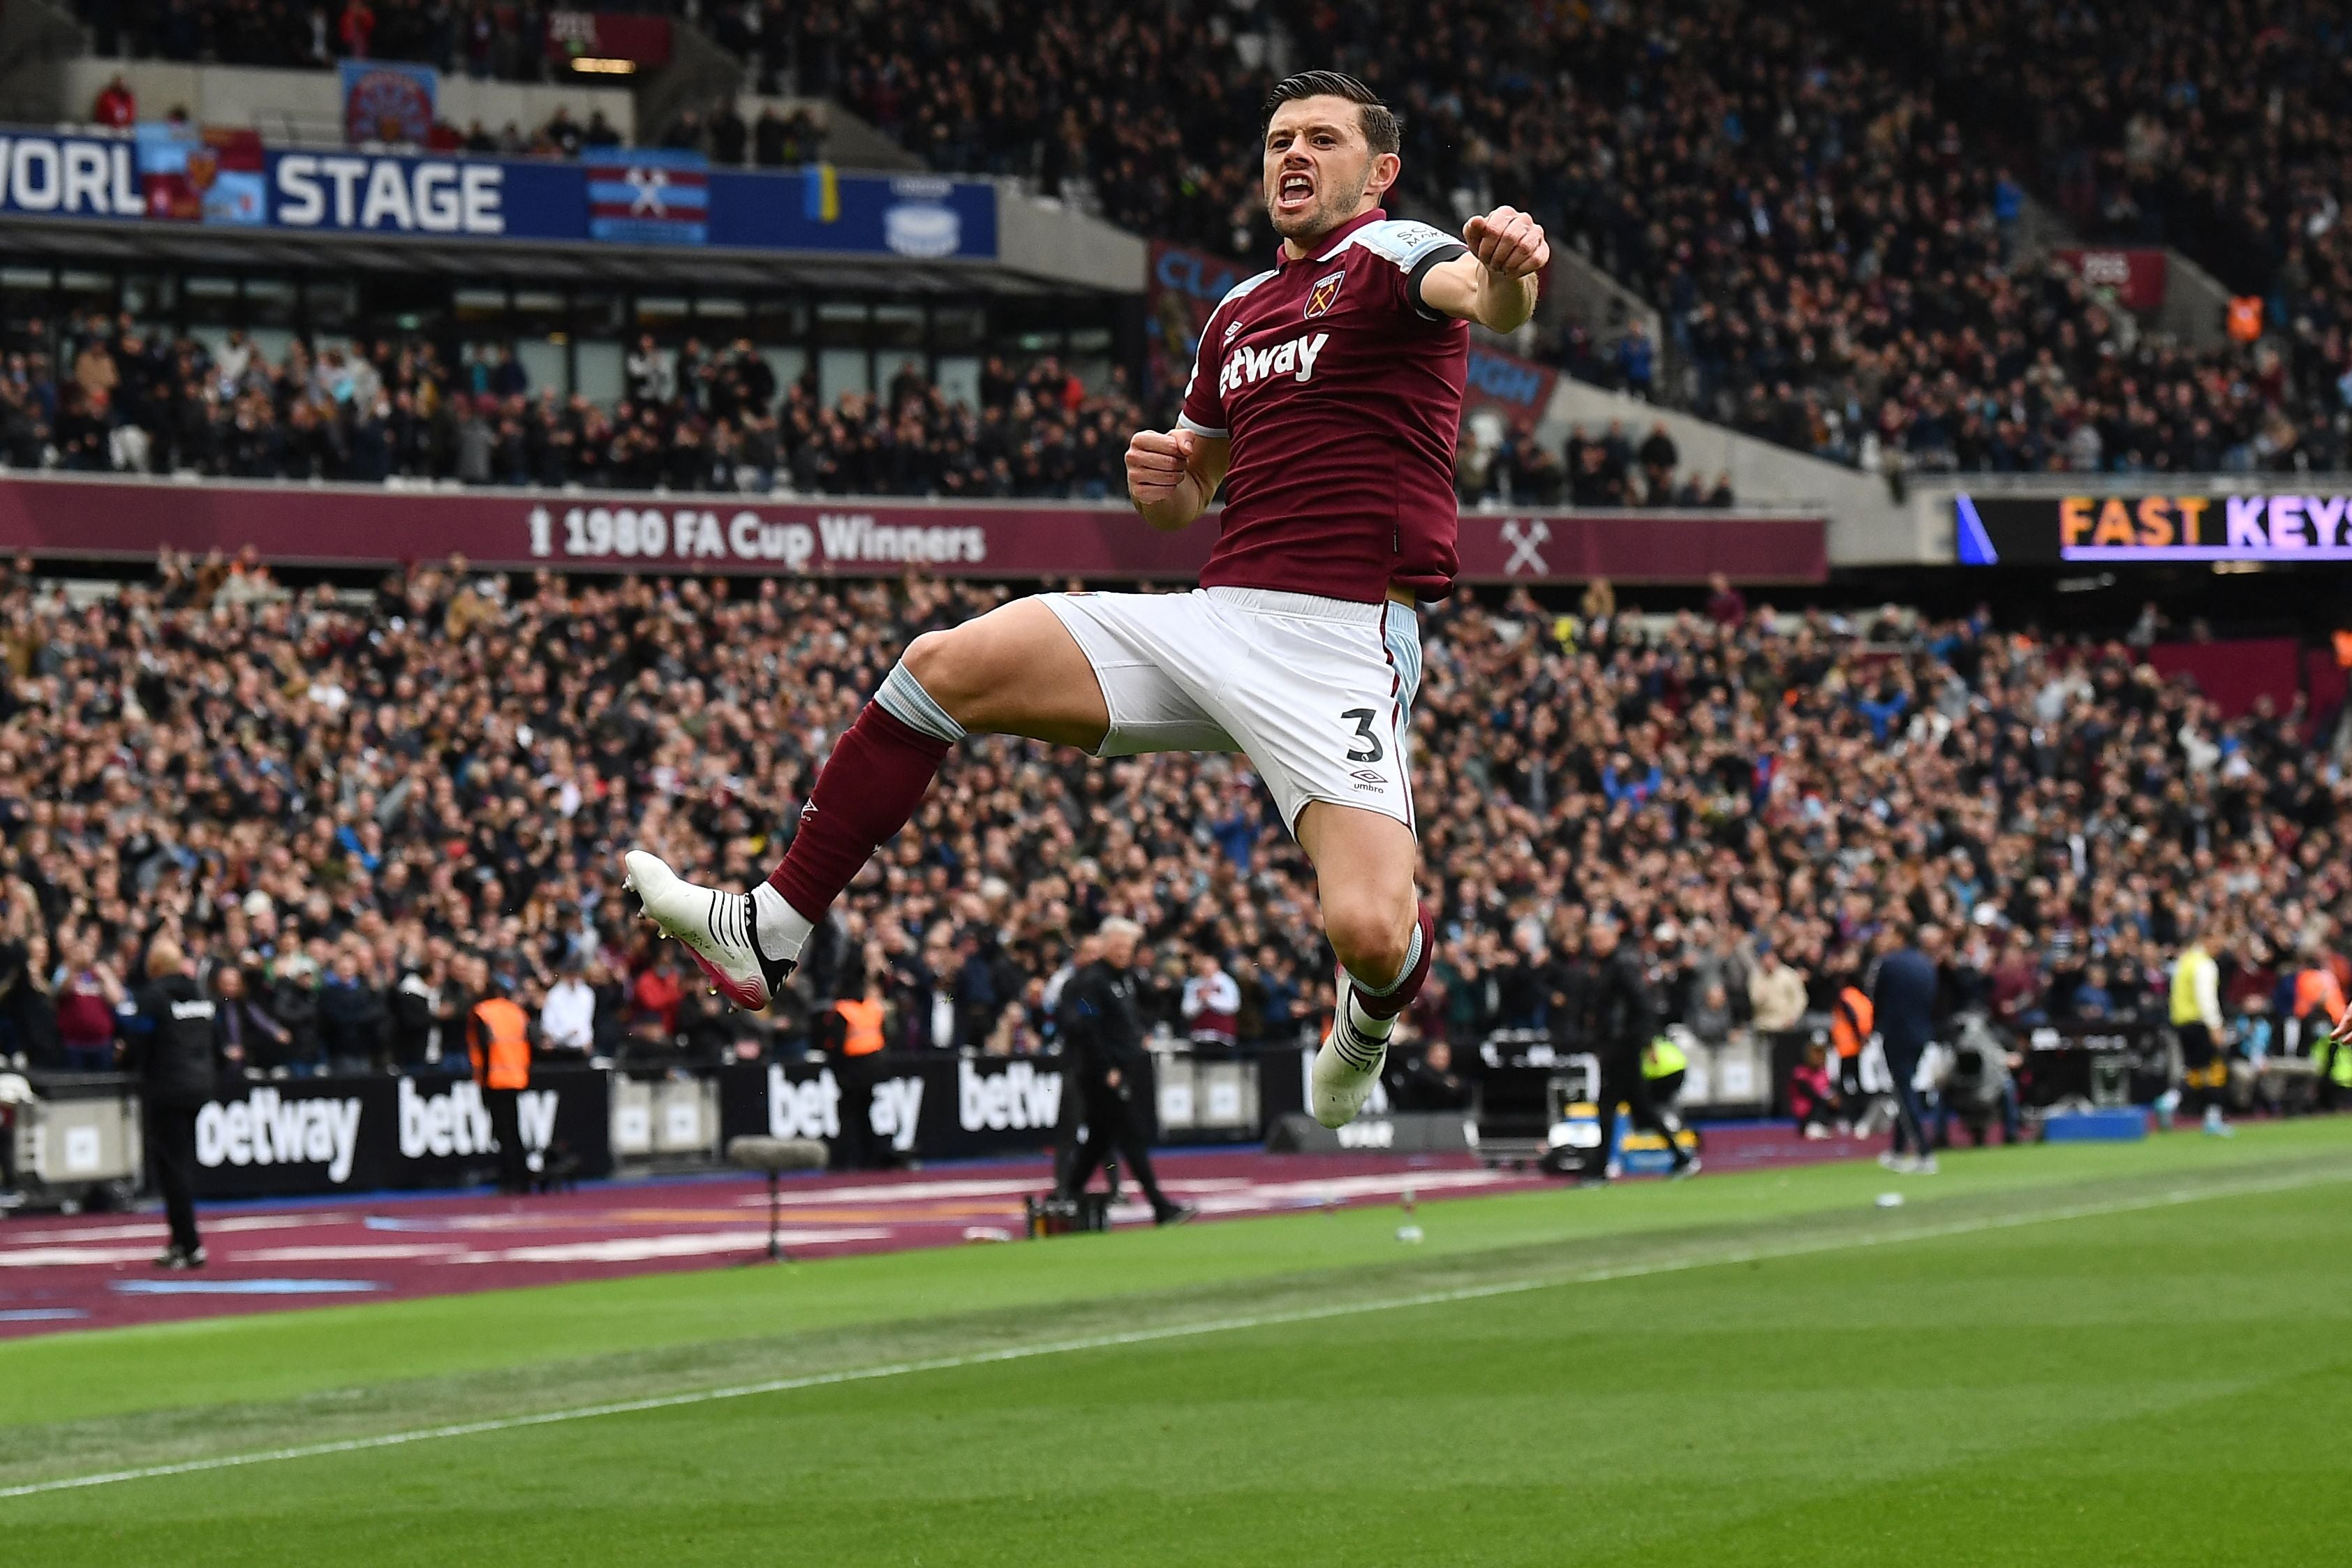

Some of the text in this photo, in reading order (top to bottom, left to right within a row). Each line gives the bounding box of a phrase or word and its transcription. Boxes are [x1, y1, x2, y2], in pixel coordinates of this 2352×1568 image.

[0, 138, 505, 233] ORL STAGE
[1220, 334, 1329, 399] etway
[563, 507, 986, 571] 1980 FA Cup Winners
[2059, 494, 2352, 547] FAST KEY
[1340, 709, 1383, 762] 3
[1354, 783, 1384, 794] umbro
[768, 1063, 925, 1151] betay
[958, 1058, 1063, 1132] betw
